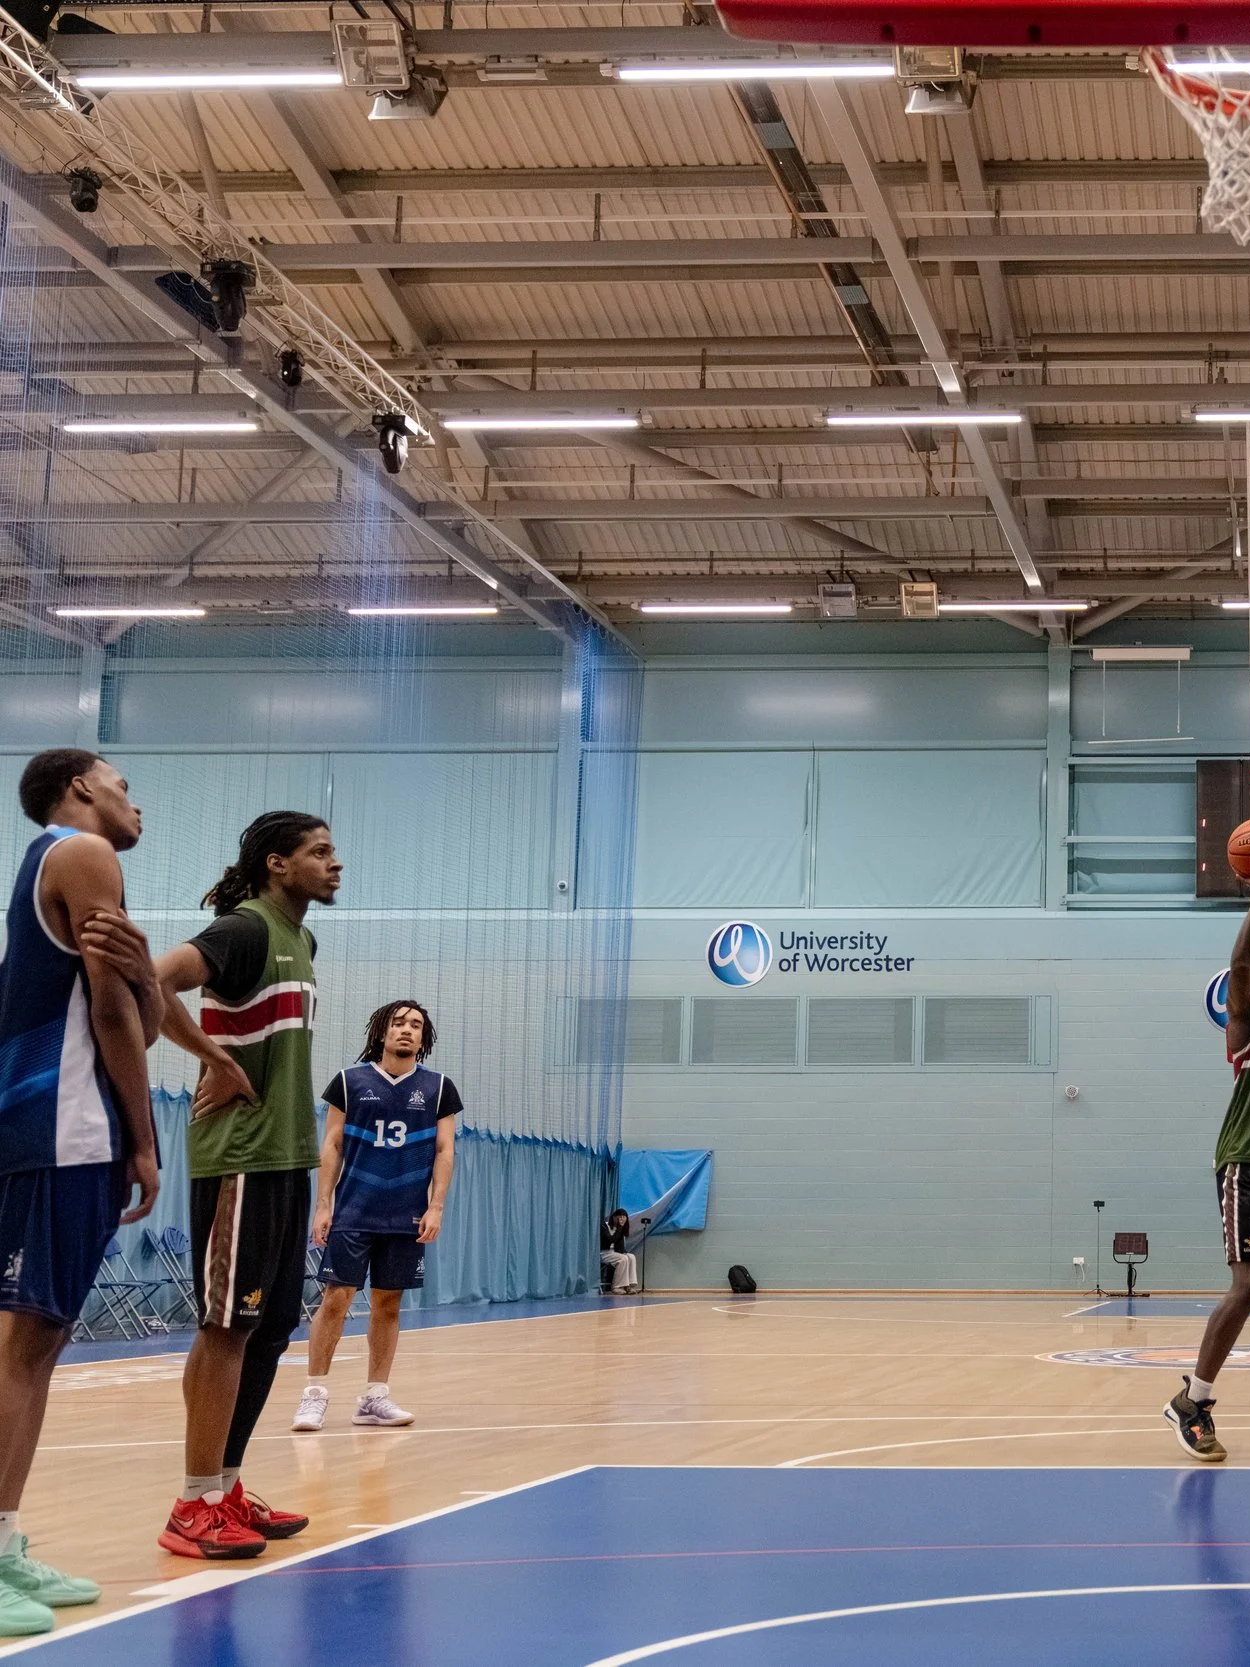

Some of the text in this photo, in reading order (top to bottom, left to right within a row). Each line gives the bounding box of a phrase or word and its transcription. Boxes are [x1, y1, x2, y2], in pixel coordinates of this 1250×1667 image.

[780, 930, 888, 956] University
[778, 952, 915, 972] of Worcester
[373, 1119, 408, 1148] 13
